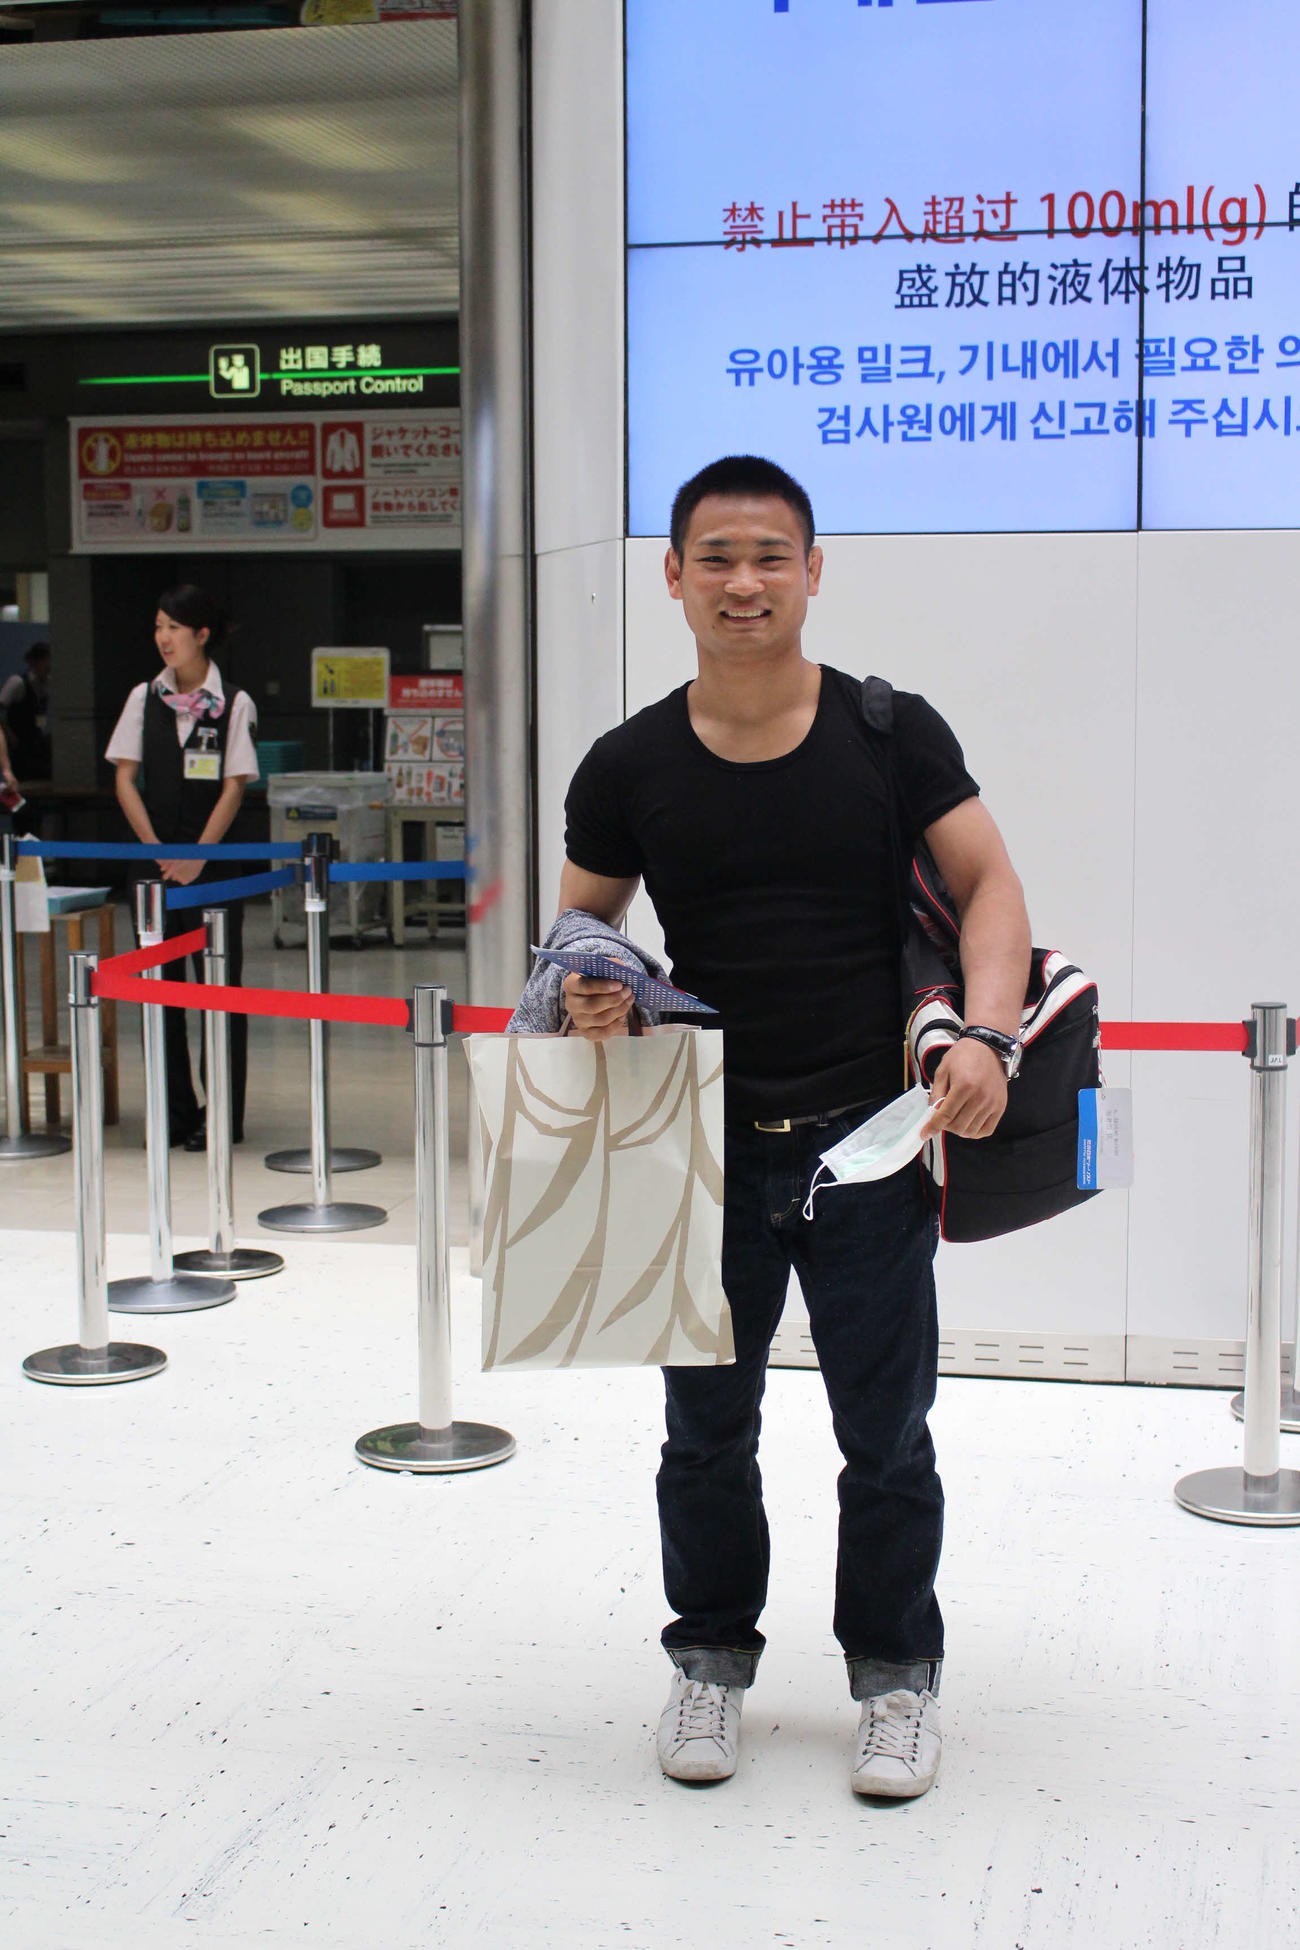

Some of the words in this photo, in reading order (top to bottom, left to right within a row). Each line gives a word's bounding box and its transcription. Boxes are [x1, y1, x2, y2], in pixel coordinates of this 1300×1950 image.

[722, 191, 1018, 252] 禁止带入超过
[1039, 184, 1267, 246] 100ml(g)
[894, 255, 1253, 309] 盛放的液体物品
[279, 343, 382, 370] 出国手続
[725, 346, 844, 386] 유아용
[857, 343, 945, 384] 밀크,
[958, 338, 1119, 381] 기내에서
[1134, 334, 1264, 376] 필요한
[280, 377, 356, 397] Passport
[360, 375, 424, 394] Control
[816, 401, 1016, 445] 검사원에게
[1030, 398, 1156, 440] 신고해
[1168, 395, 1300, 438] 주십시
